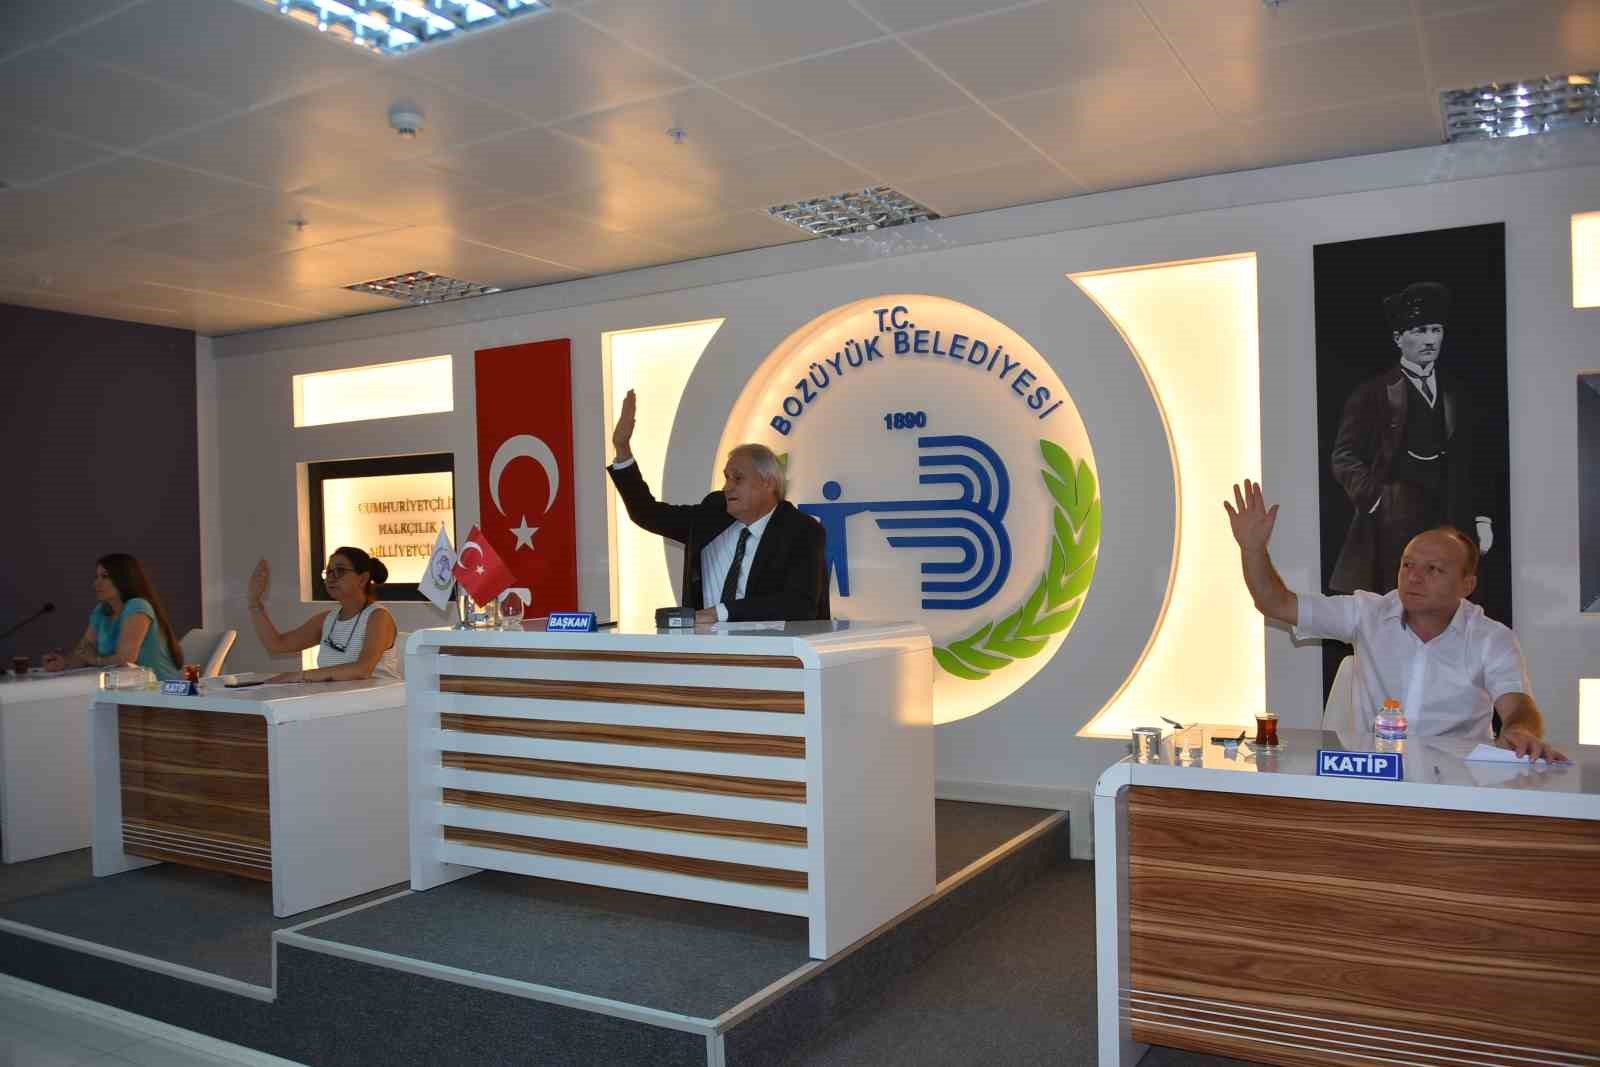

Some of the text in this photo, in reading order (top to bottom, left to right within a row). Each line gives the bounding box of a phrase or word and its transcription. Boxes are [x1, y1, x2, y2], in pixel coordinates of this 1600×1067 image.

[873, 306, 915, 332] T.C.
[770, 330, 1063, 436] BOZÜYÜK BELEDİYESİ
[884, 411, 927, 429] 1890
[358, 496, 453, 513] CUMHURİYETÇİLİ
[378, 521, 437, 535] HALKÇILIK
[369, 544, 433, 559] MİLLİYETÇİ
[550, 615, 588, 629] BAŞKAN
[1323, 754, 1388, 773] KATİP
